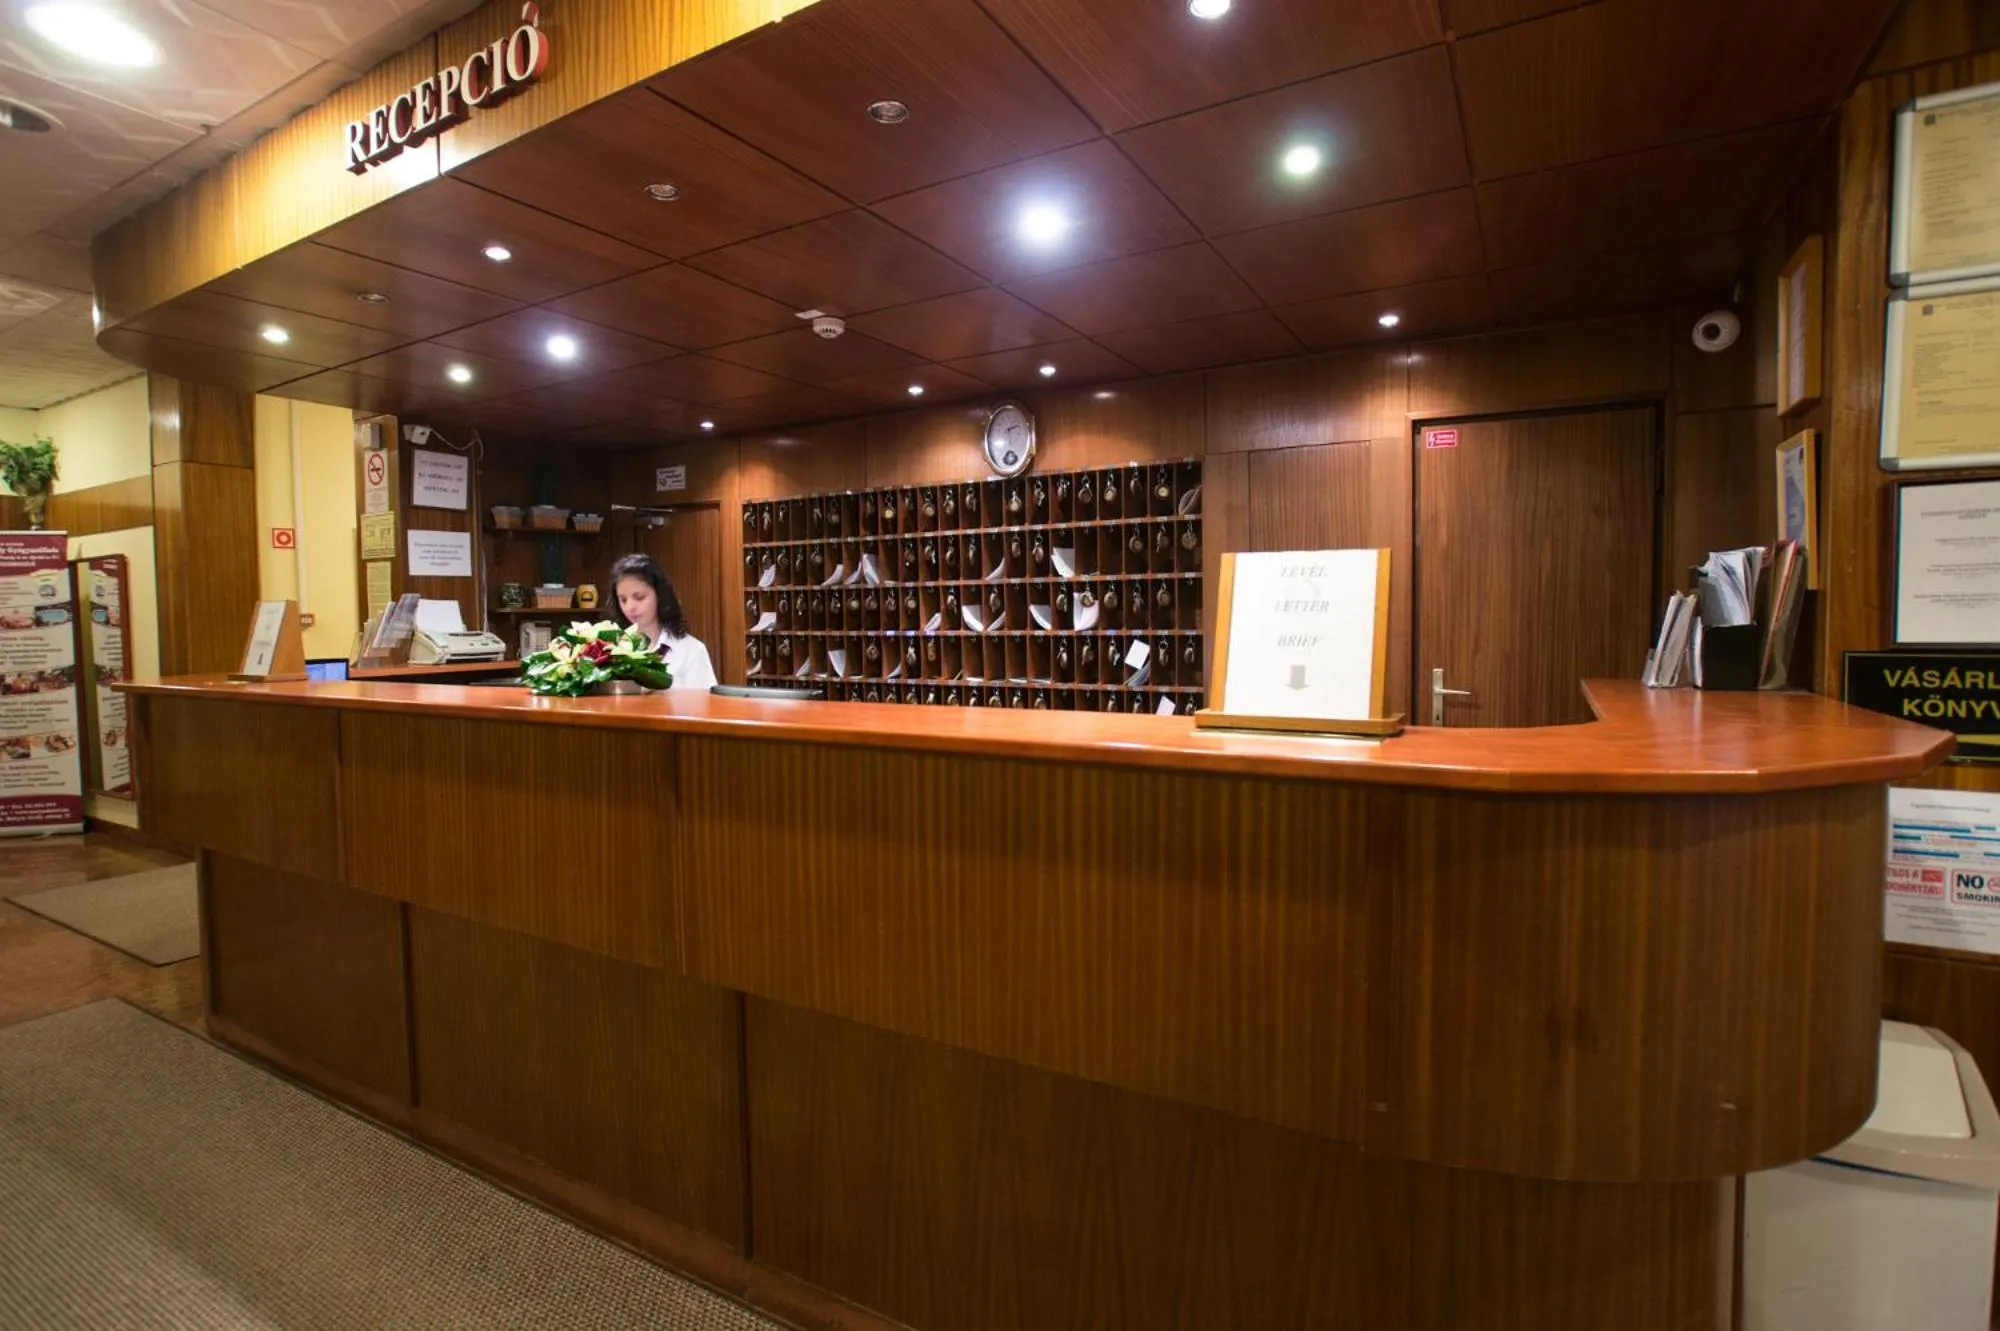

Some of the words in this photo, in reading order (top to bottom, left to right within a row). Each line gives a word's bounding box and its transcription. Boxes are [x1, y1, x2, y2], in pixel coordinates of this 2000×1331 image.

[345, 1, 544, 168] RECEPCIÓ
[1274, 599, 1330, 613] LETTER
[1277, 634, 1322, 647] BRIEF
[1883, 666, 2000, 689] VÁSÁRL
[1956, 873, 1985, 889] NO
